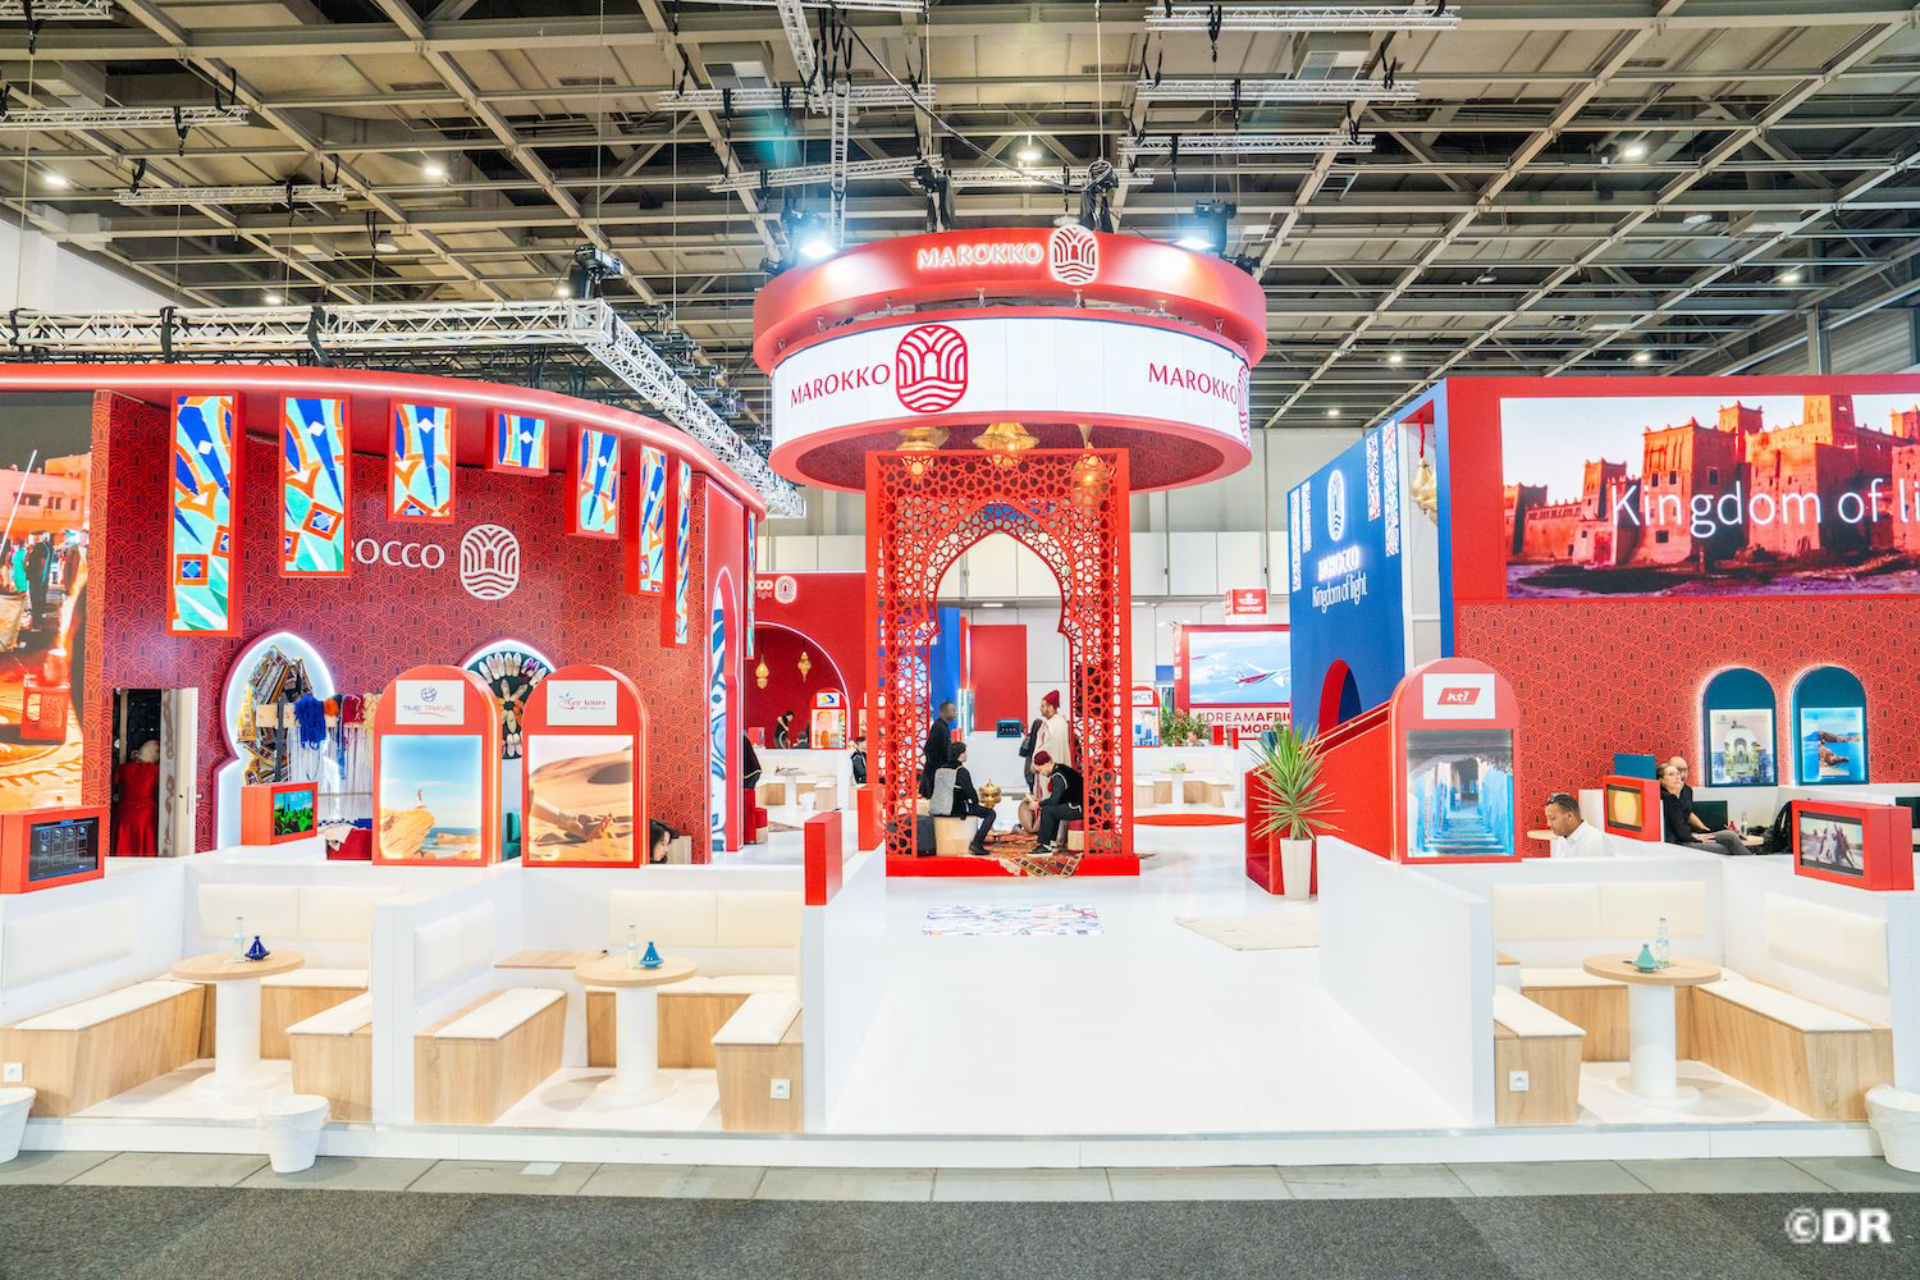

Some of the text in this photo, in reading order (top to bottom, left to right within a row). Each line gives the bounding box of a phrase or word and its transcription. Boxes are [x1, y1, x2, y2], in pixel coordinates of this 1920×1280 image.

[917, 243, 1044, 269] MAROKKO
[790, 364, 891, 408] MAROKKO
[1149, 362, 1237, 405] MAROKKO
[1612, 480, 1821, 539] Kingdom
[1838, 478, 1884, 523] of
[351, 538, 446, 569] OCCO
